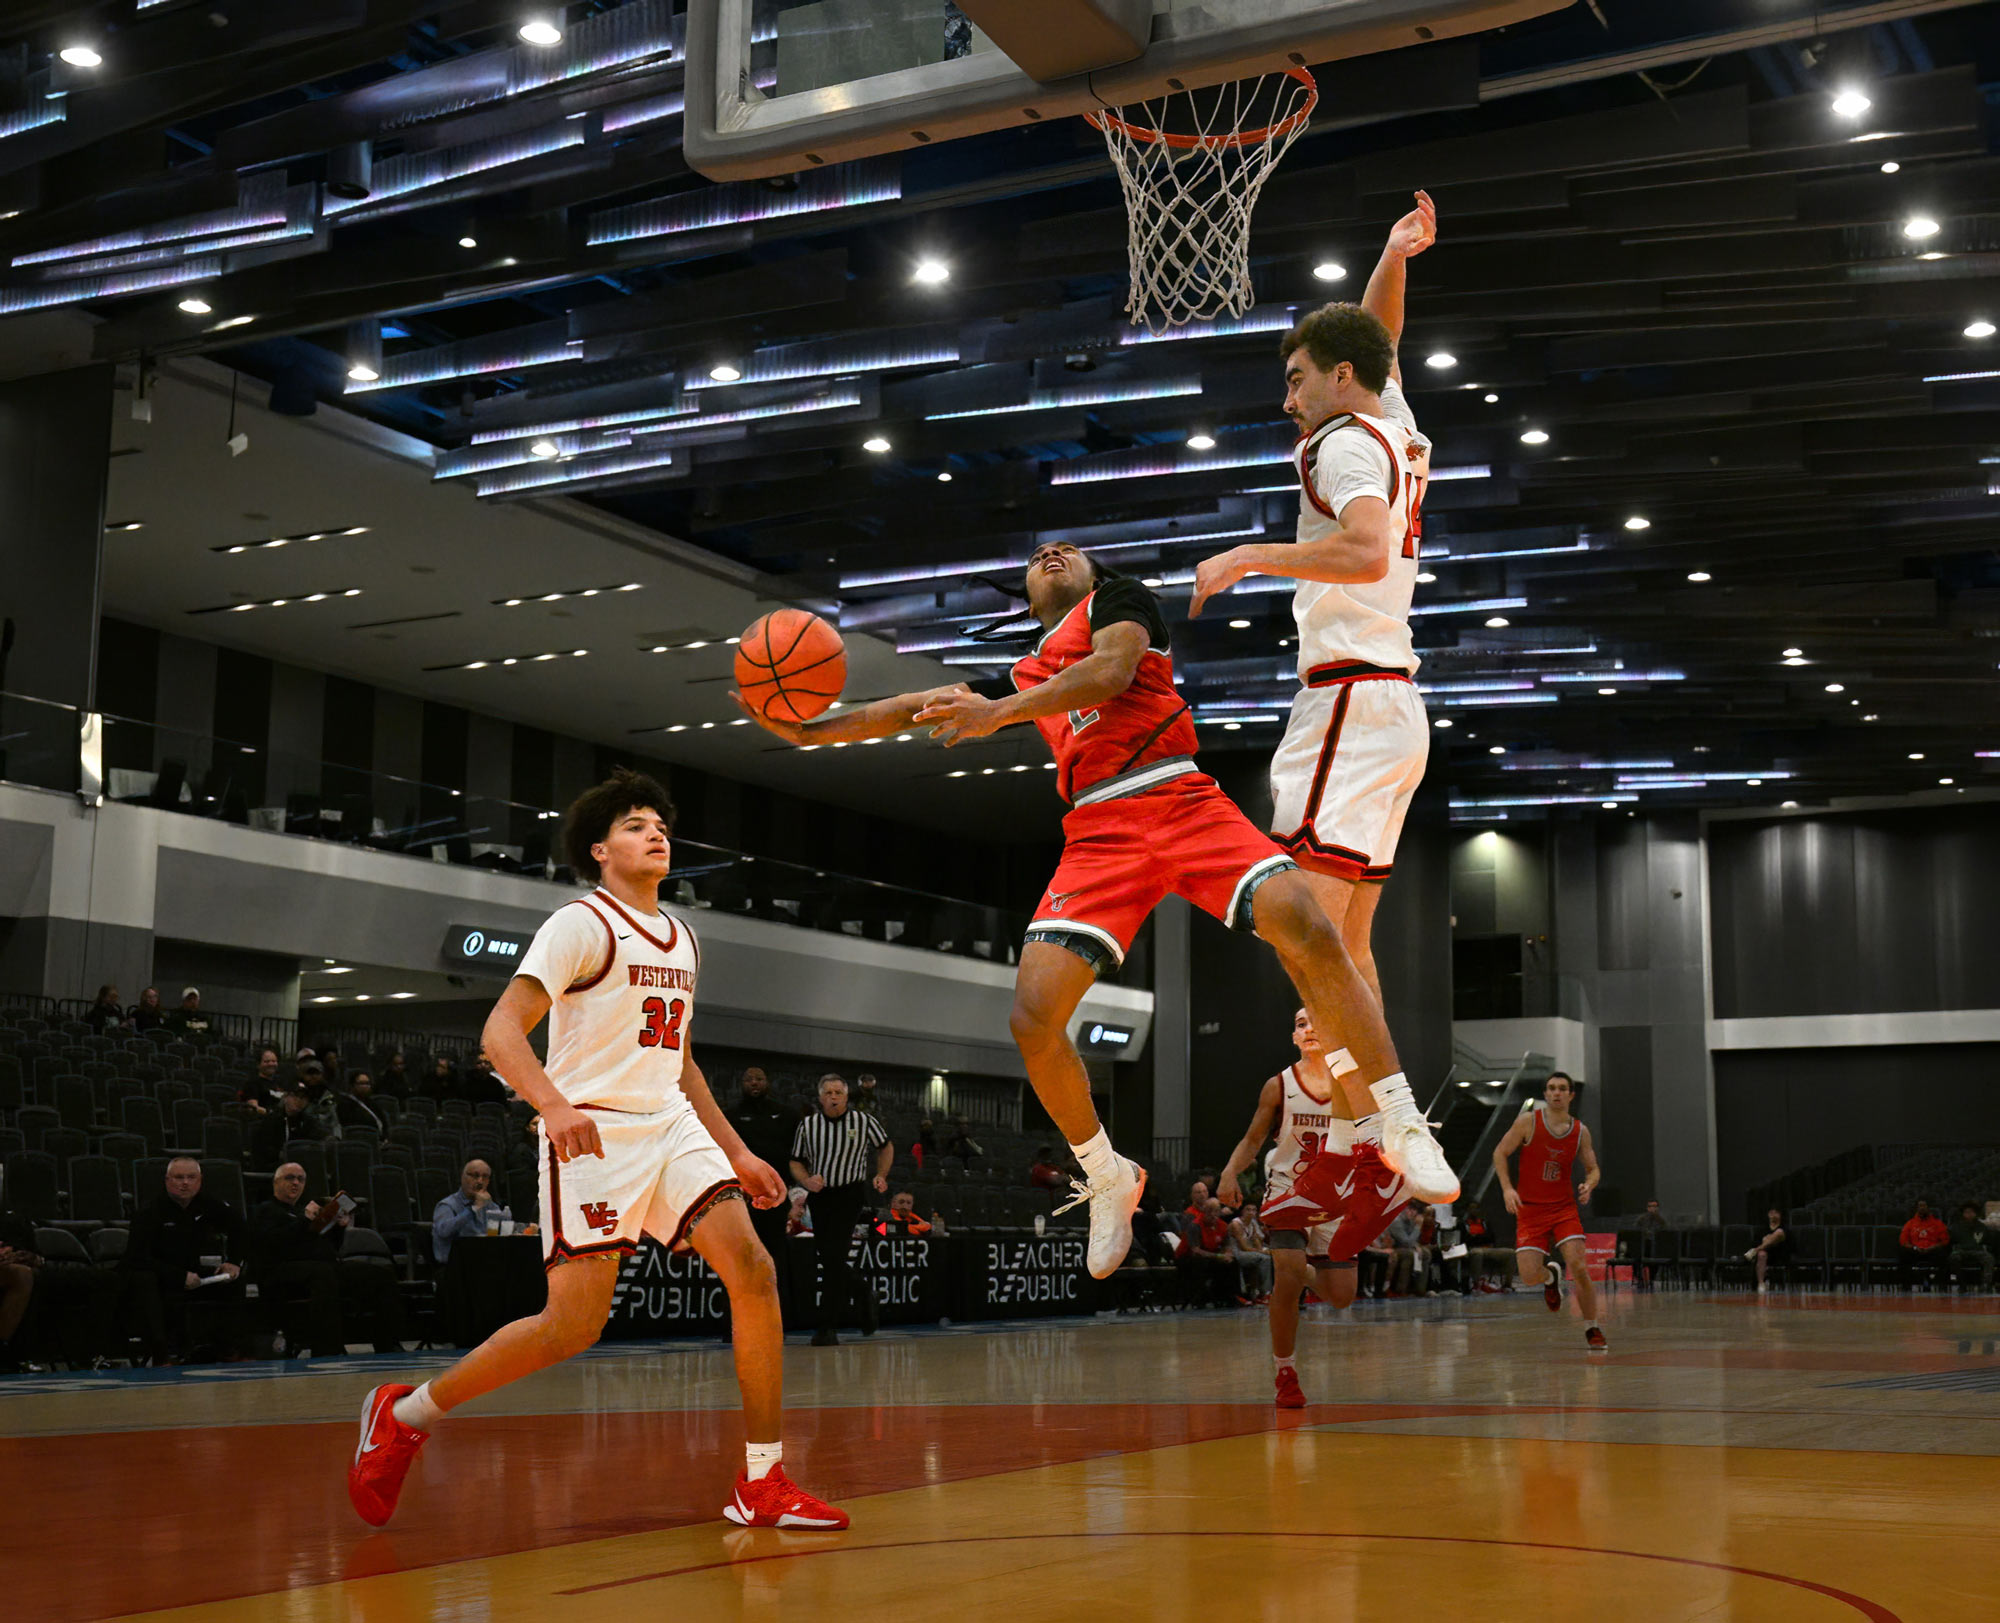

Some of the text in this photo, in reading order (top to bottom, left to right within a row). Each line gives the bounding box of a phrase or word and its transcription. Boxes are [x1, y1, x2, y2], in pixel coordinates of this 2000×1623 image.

[638, 996, 685, 1051] 32
[987, 1242, 1084, 1270] BLEACHER
[608, 1283, 724, 1319] EPUBLIC
[987, 1273, 1078, 1303] REPUBLIC
